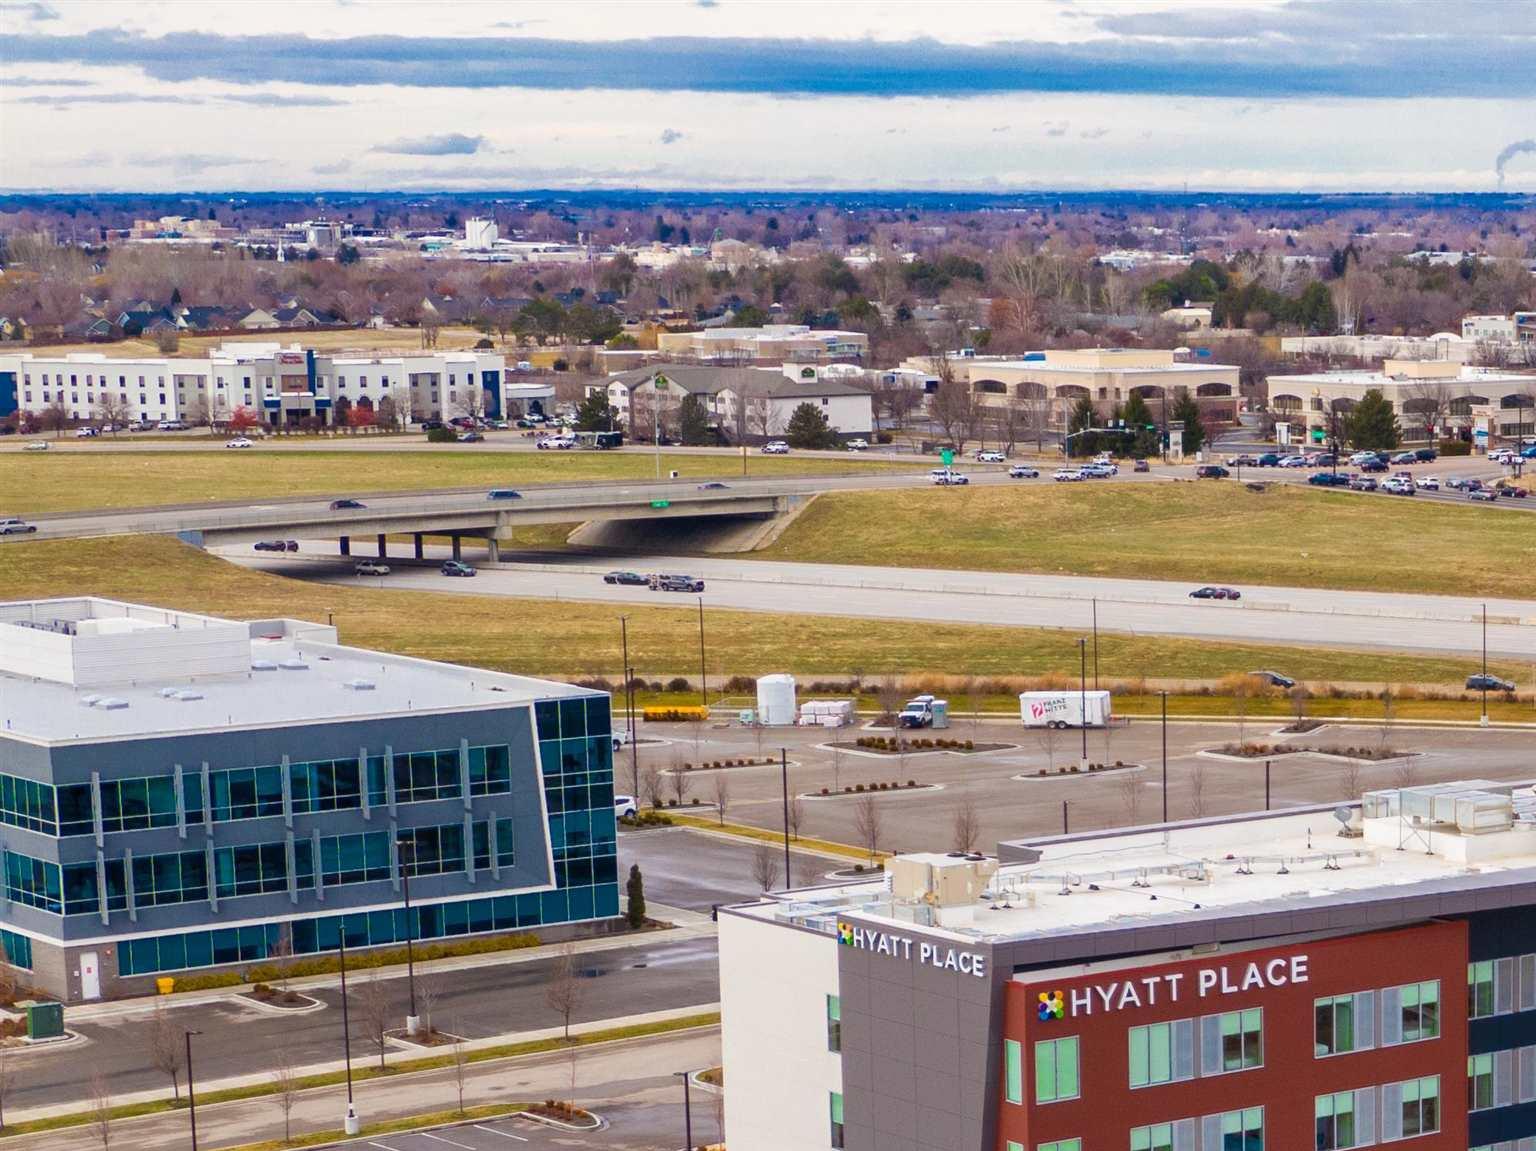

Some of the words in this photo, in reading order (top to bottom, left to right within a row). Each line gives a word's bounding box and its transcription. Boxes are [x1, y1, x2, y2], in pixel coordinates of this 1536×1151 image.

[853, 927, 912, 960] HYATT
[920, 942, 985, 977] PLACE
[1071, 973, 1183, 1017] HYATT
[1199, 955, 1309, 997] PLACE
